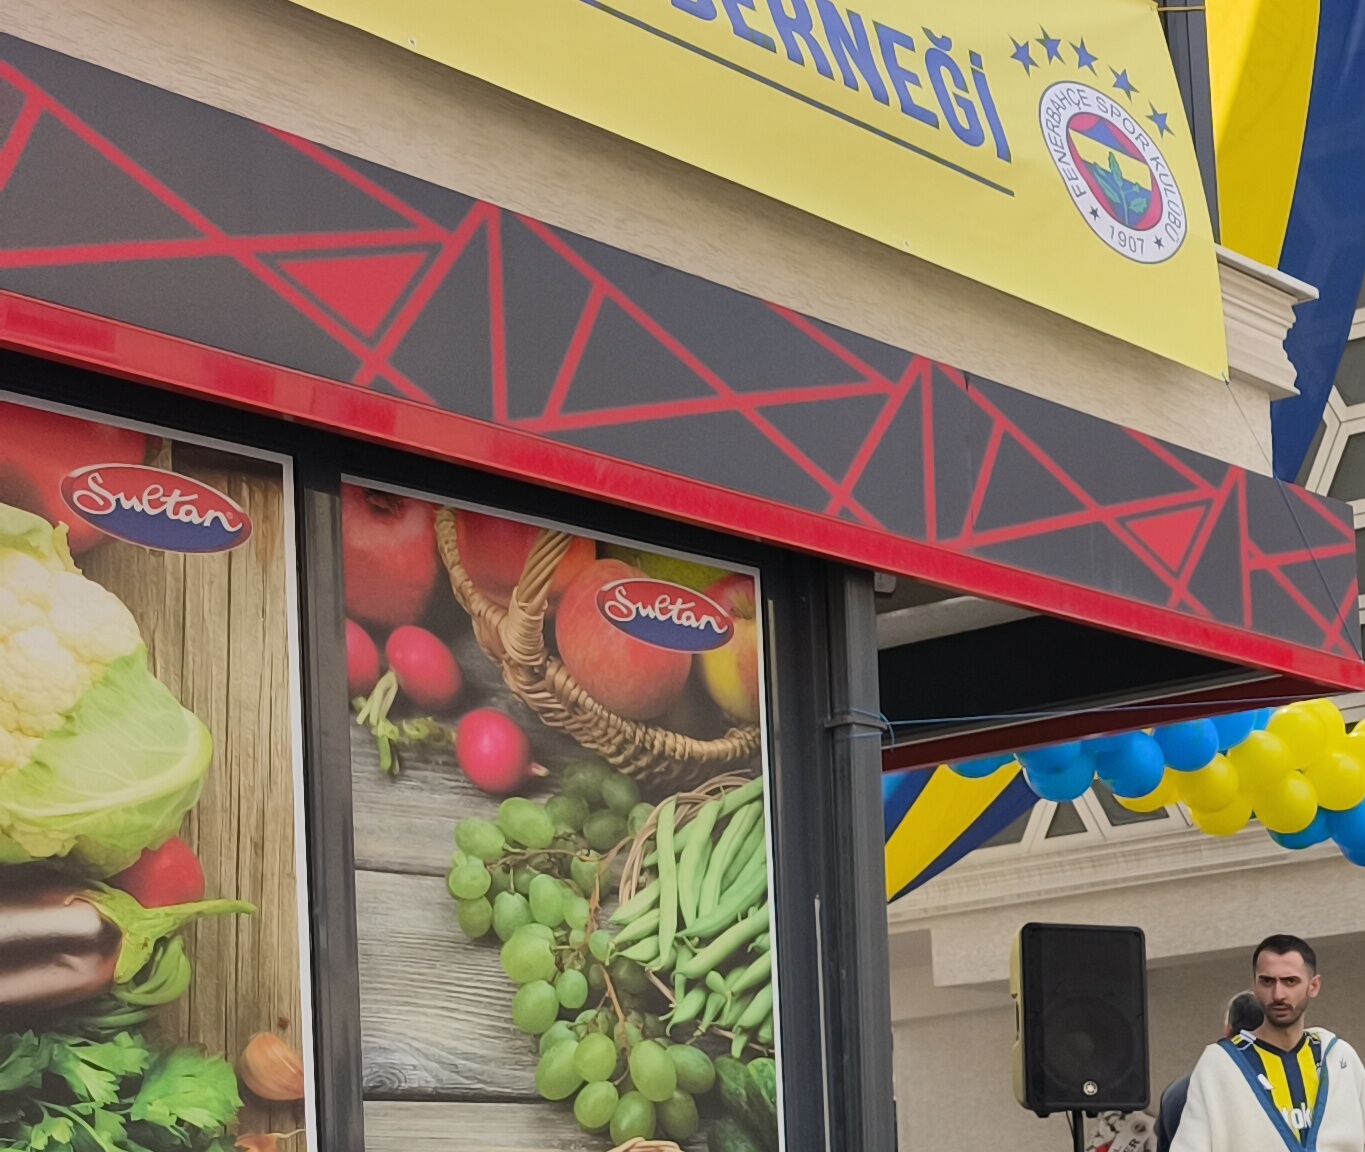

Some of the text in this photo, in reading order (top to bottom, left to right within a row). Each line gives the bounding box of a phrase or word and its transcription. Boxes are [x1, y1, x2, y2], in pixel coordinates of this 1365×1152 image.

[671, 0, 1012, 163] ERNEĞİ
[1045, 87, 1092, 198] FENERBAHÇE
[1095, 95, 1151, 150] SPOR
[1109, 225, 1145, 254] 1907
[72, 472, 243, 532] Sultan
[604, 586, 728, 634] Sultan
